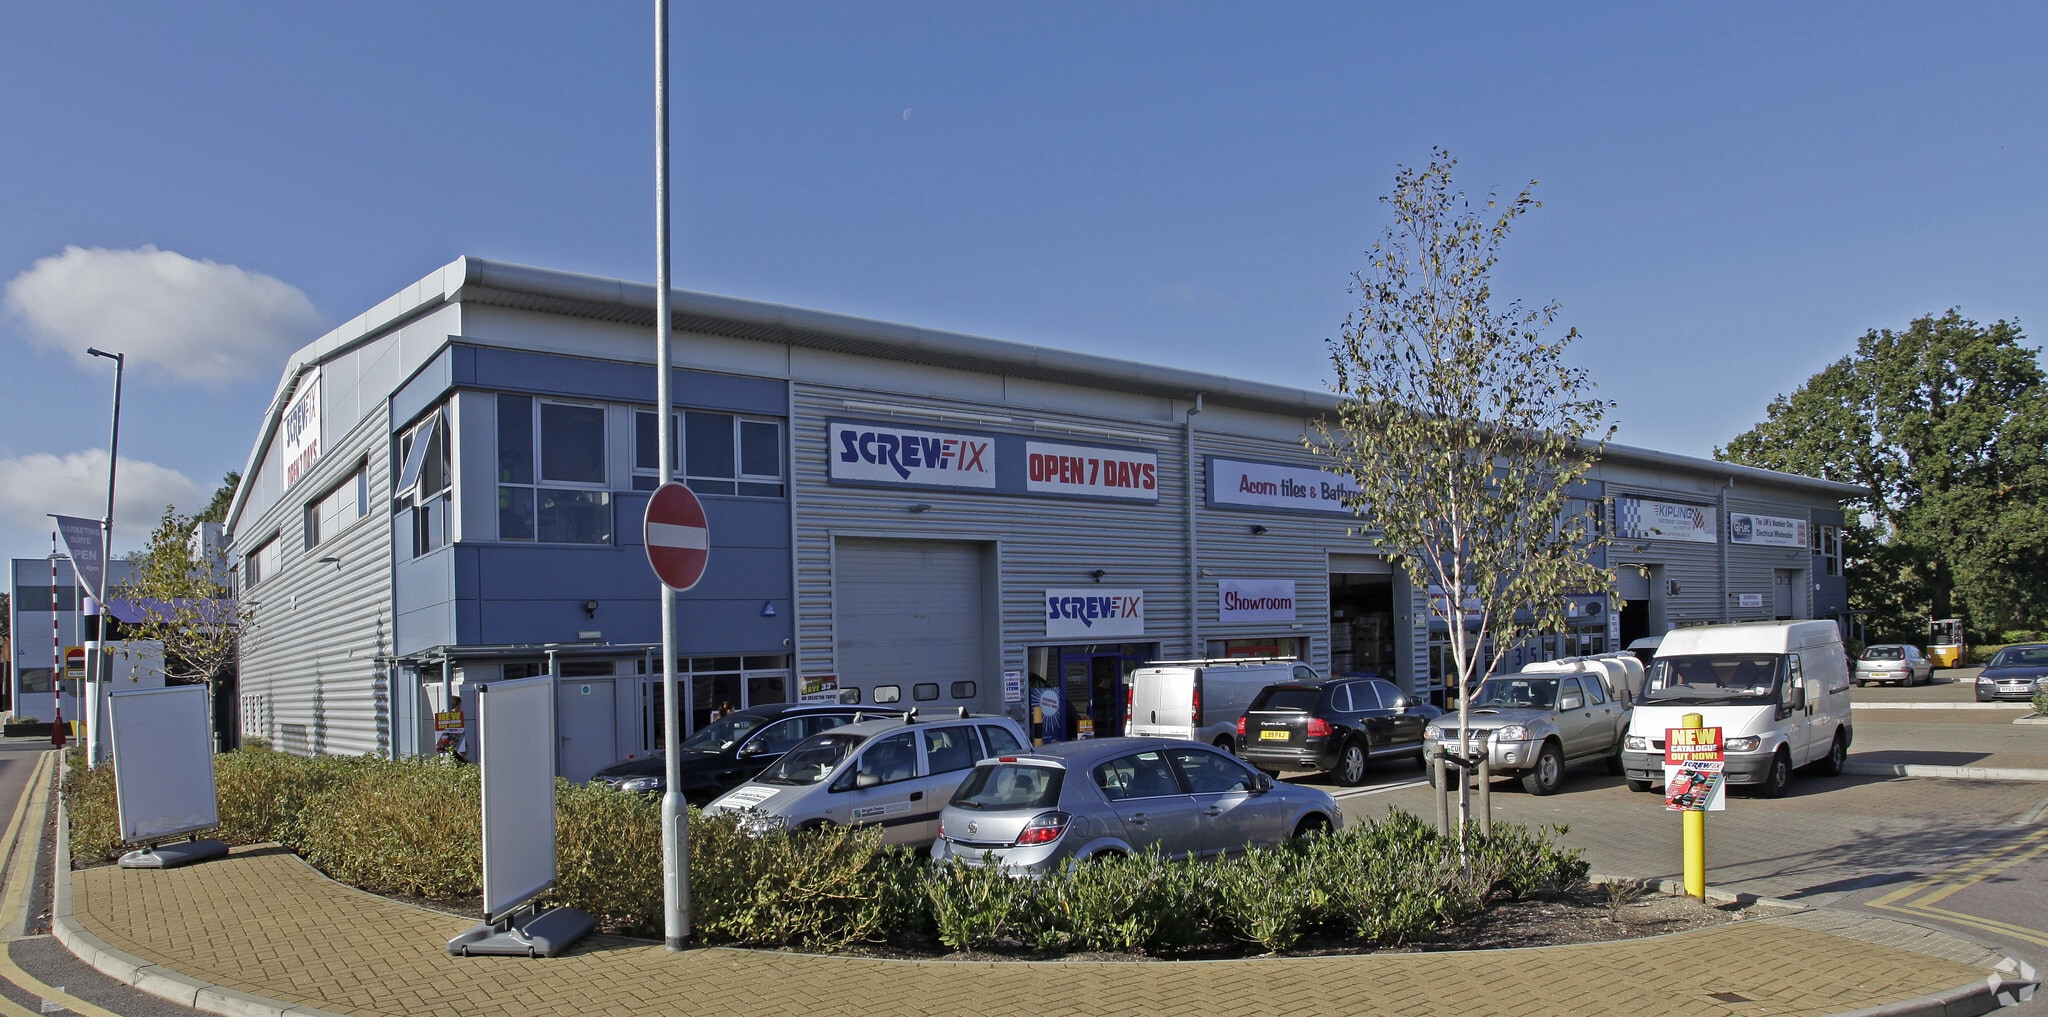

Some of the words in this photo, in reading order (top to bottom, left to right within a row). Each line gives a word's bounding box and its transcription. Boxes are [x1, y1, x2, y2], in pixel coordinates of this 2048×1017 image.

[286, 383, 316, 449] SCREWFIX
[840, 429, 988, 480] SCREWFIX
[1029, 453, 1084, 484] OPEN
[1088, 458, 1099, 485] 7
[1103, 460, 1155, 490] DAYS
[1239, 473, 1277, 496] Acorn
[1281, 478, 1306, 498] tiles
[1310, 486, 1317, 498] &
[1659, 504, 1692, 519] KIPLING
[1772, 520, 1786, 528] Number
[1756, 528, 1774, 537] Electrical
[1774, 530, 1793, 538] Wholesaler
[70, 535, 92, 545] SUITE
[71, 549, 97, 560] PEN
[1225, 591, 1292, 611] Showroom
[1049, 596, 1141, 628] SCREWFIX
[1515, 647, 1522, 666] 3
[1530, 647, 1537, 663] 5
[802, 684, 820, 694] SAVE
[438, 712, 460, 720] NEW
[1671, 728, 1716, 745] NEW
[1670, 744, 1718, 752] CATALOGUE
[1671, 752, 1689, 760] OUT
[1692, 752, 1718, 760] NOW!
[1683, 761, 1723, 769] SCREWFIX
